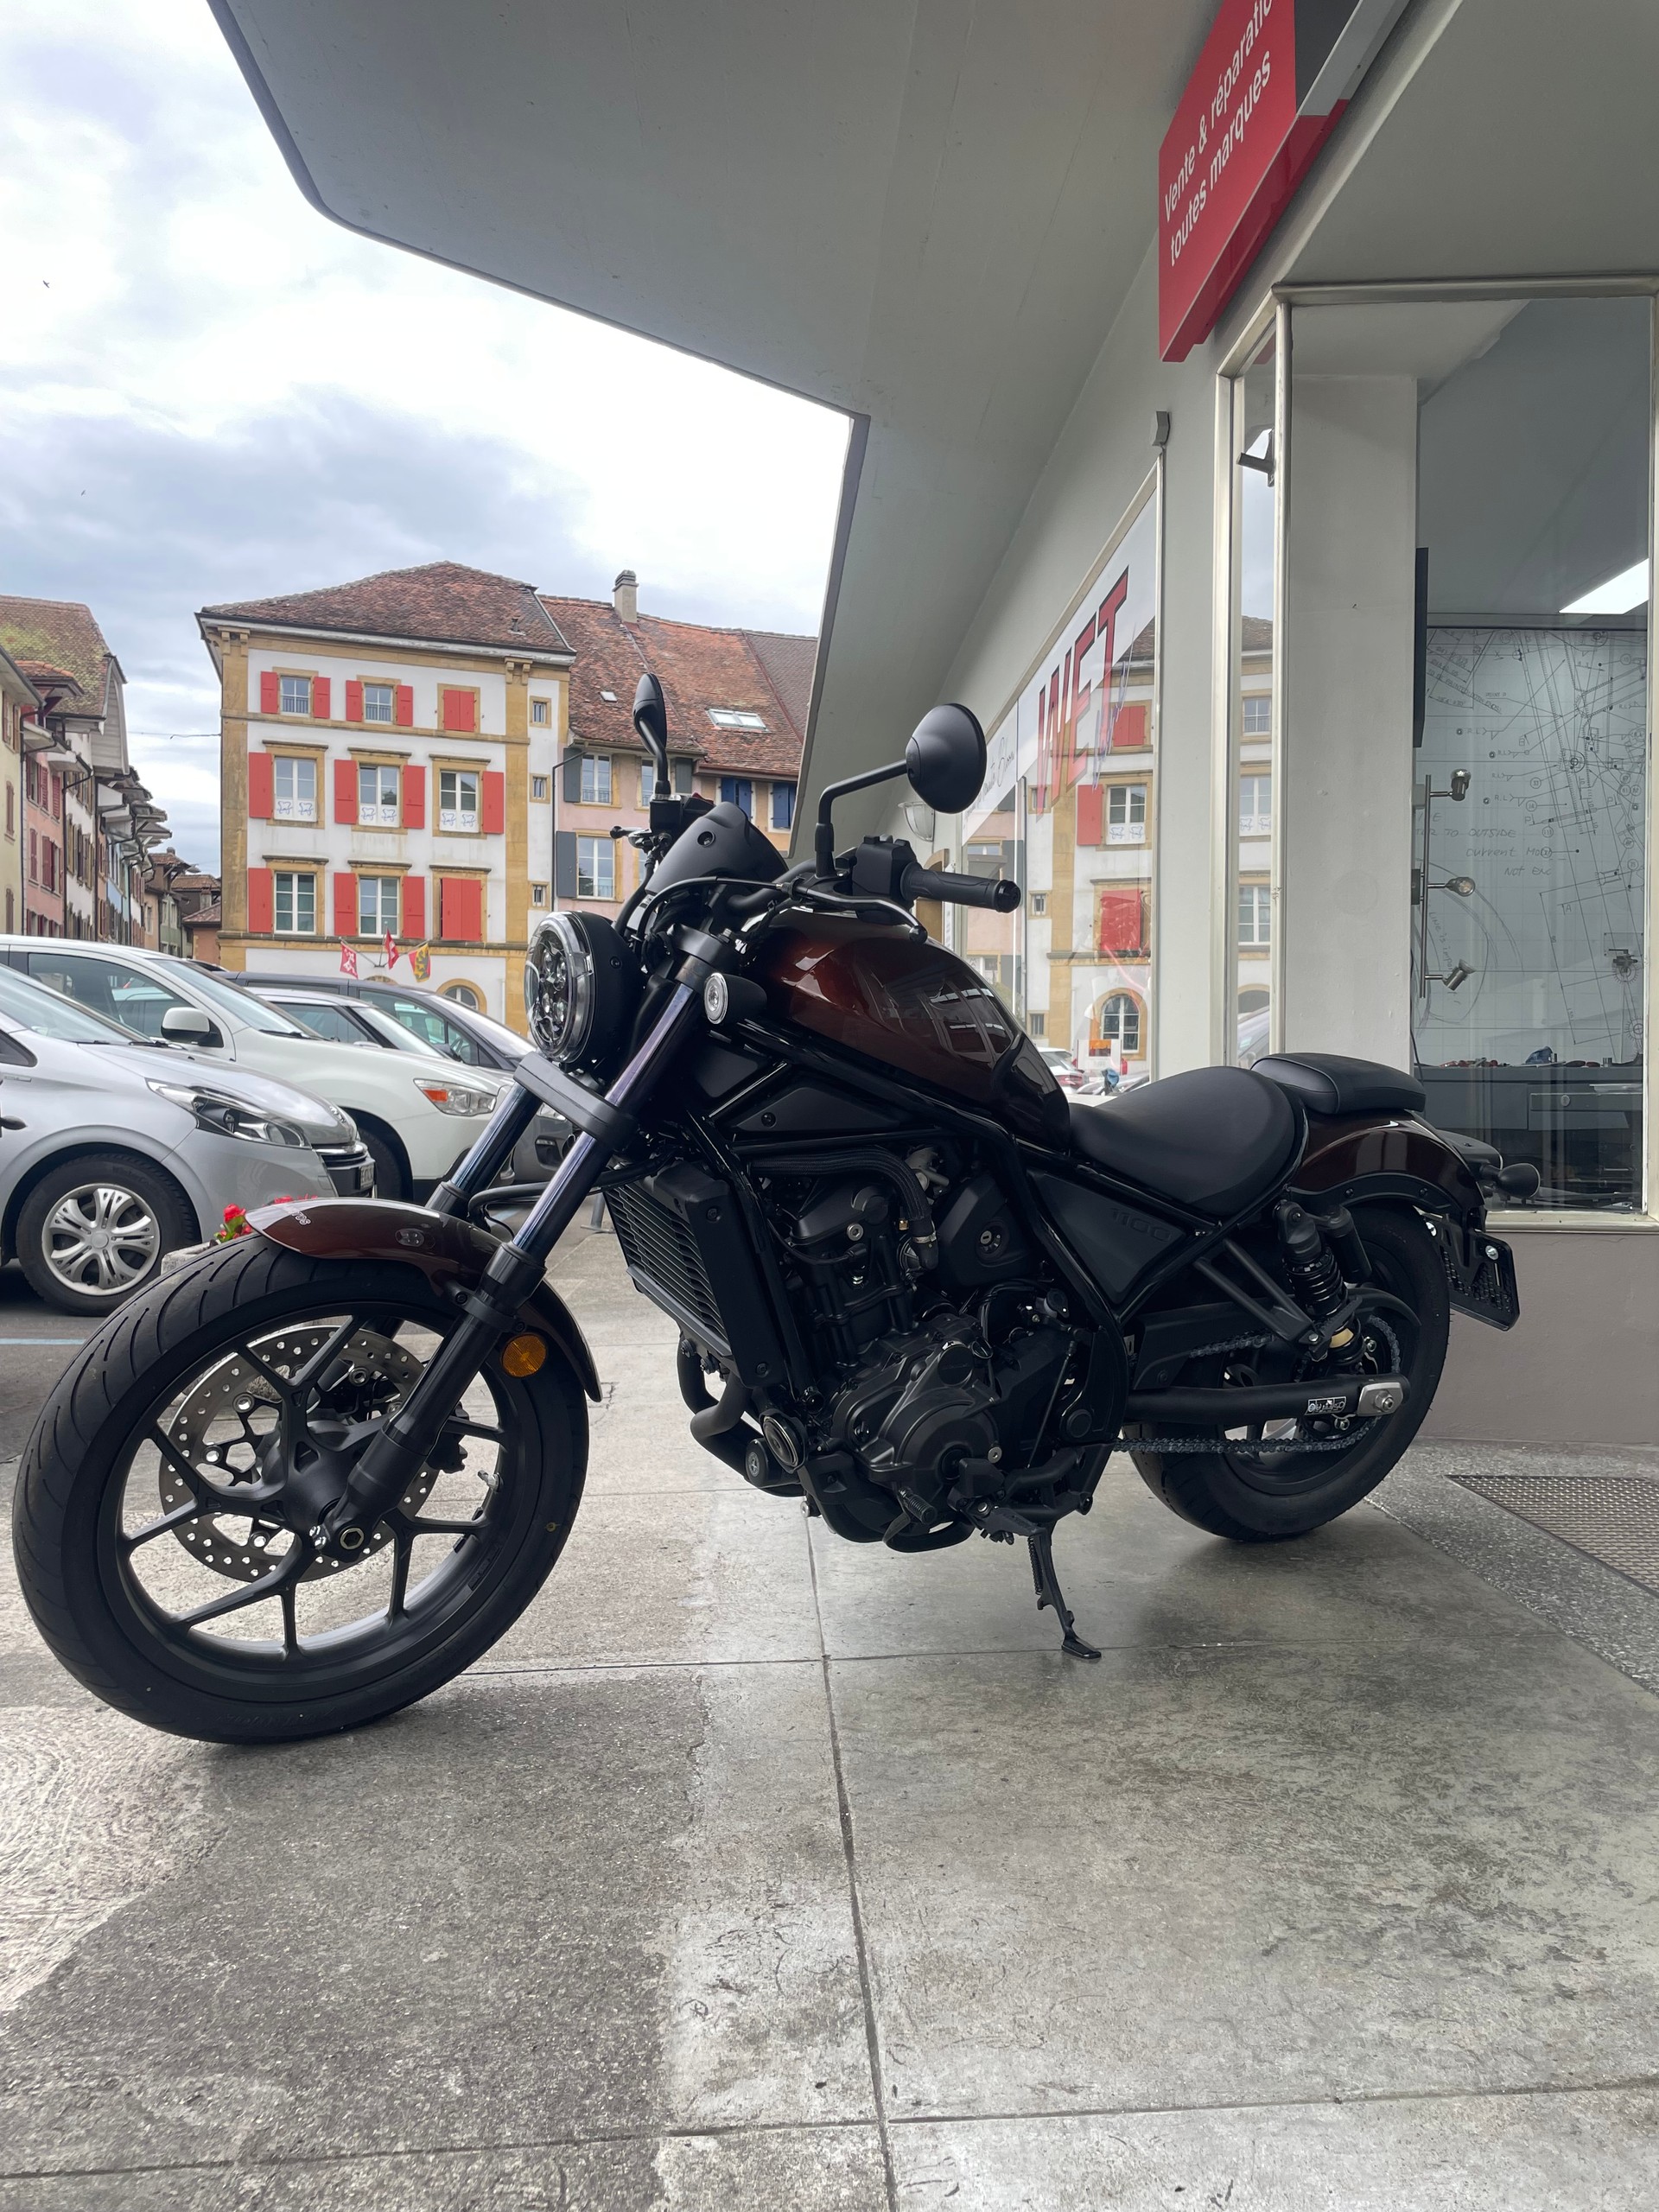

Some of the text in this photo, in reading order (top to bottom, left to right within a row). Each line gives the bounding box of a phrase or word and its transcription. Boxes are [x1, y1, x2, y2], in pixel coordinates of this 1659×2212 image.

[1165, 146, 1196, 223] Vente
[1198, 114, 1207, 154] &
[1170, 50, 1271, 267] toutes marques
[1037, 564, 1129, 821] WET
[1470, 828, 1517, 838] OUTSIDE
